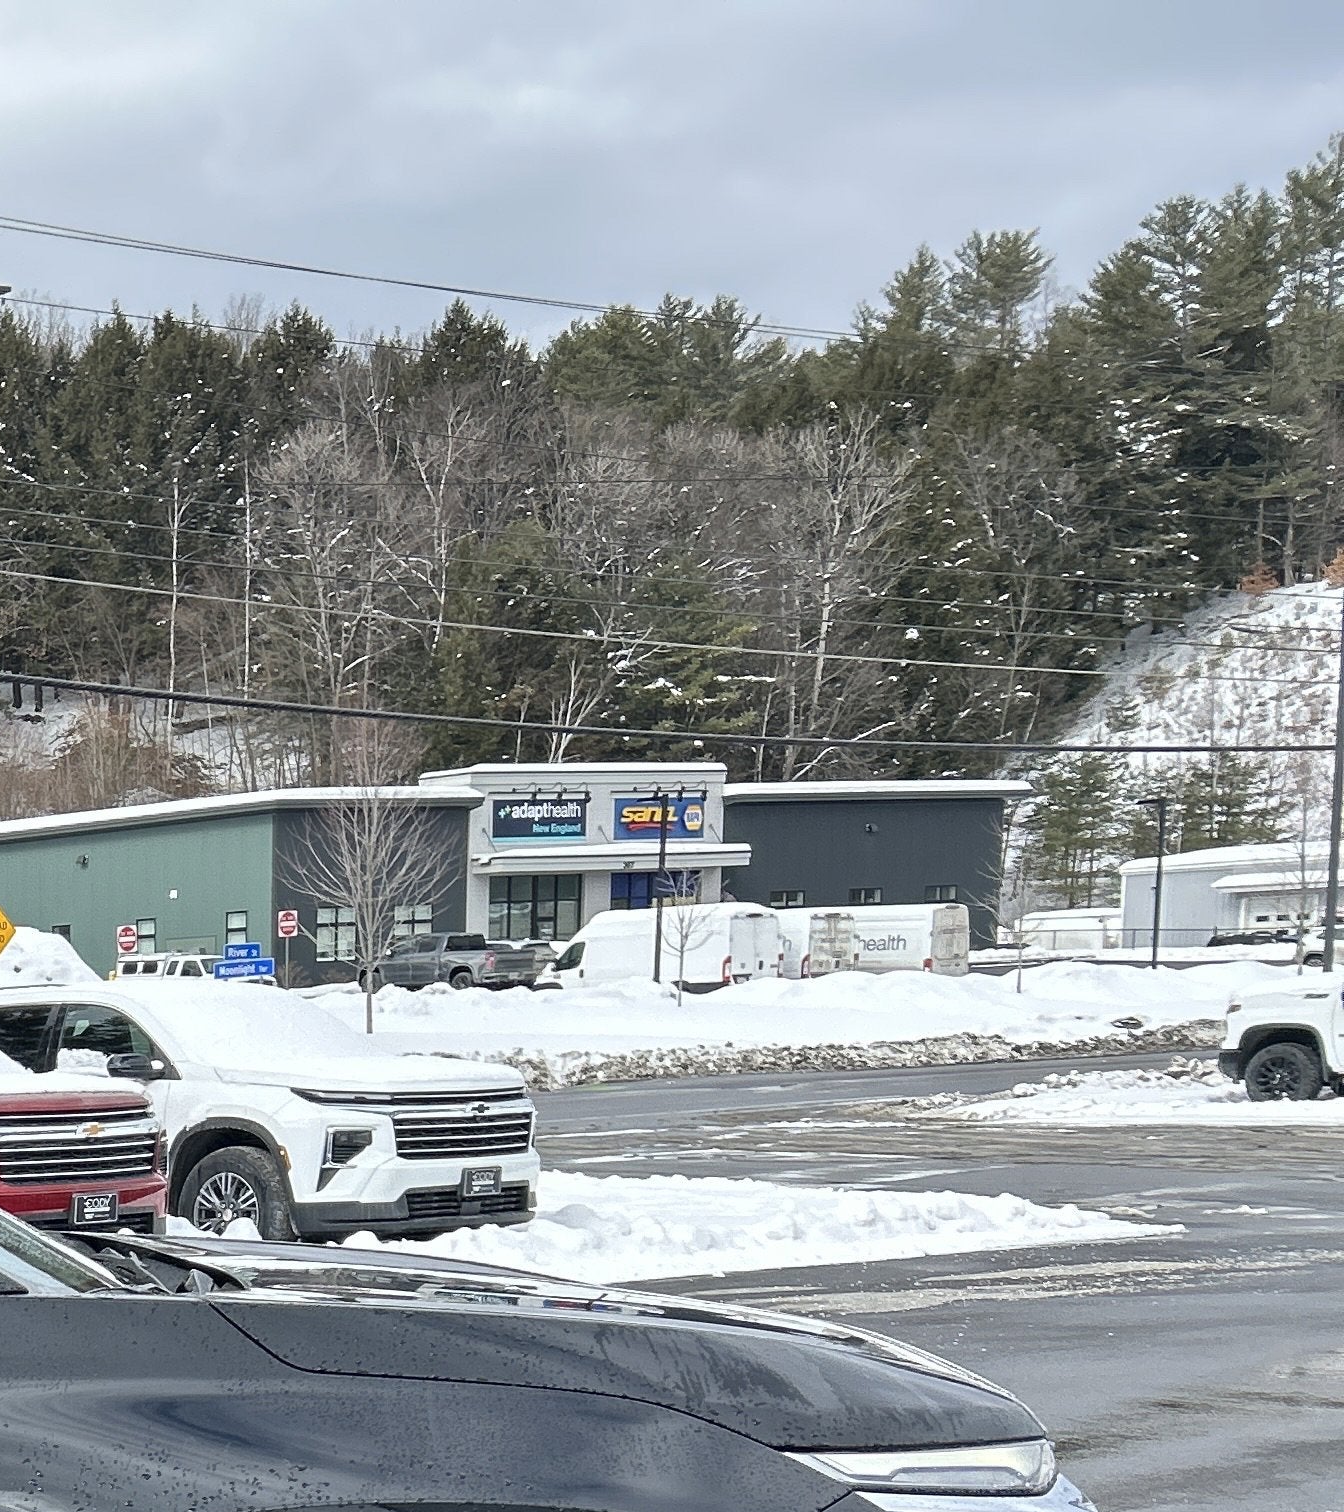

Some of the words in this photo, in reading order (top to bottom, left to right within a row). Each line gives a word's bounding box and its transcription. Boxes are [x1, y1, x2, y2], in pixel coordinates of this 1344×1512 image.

[512, 802, 581, 821] adapthealth
[620, 806, 678, 823] sanl
[533, 824, 550, 833] New
[551, 823, 581, 834] England
[228, 948, 249, 957] River
